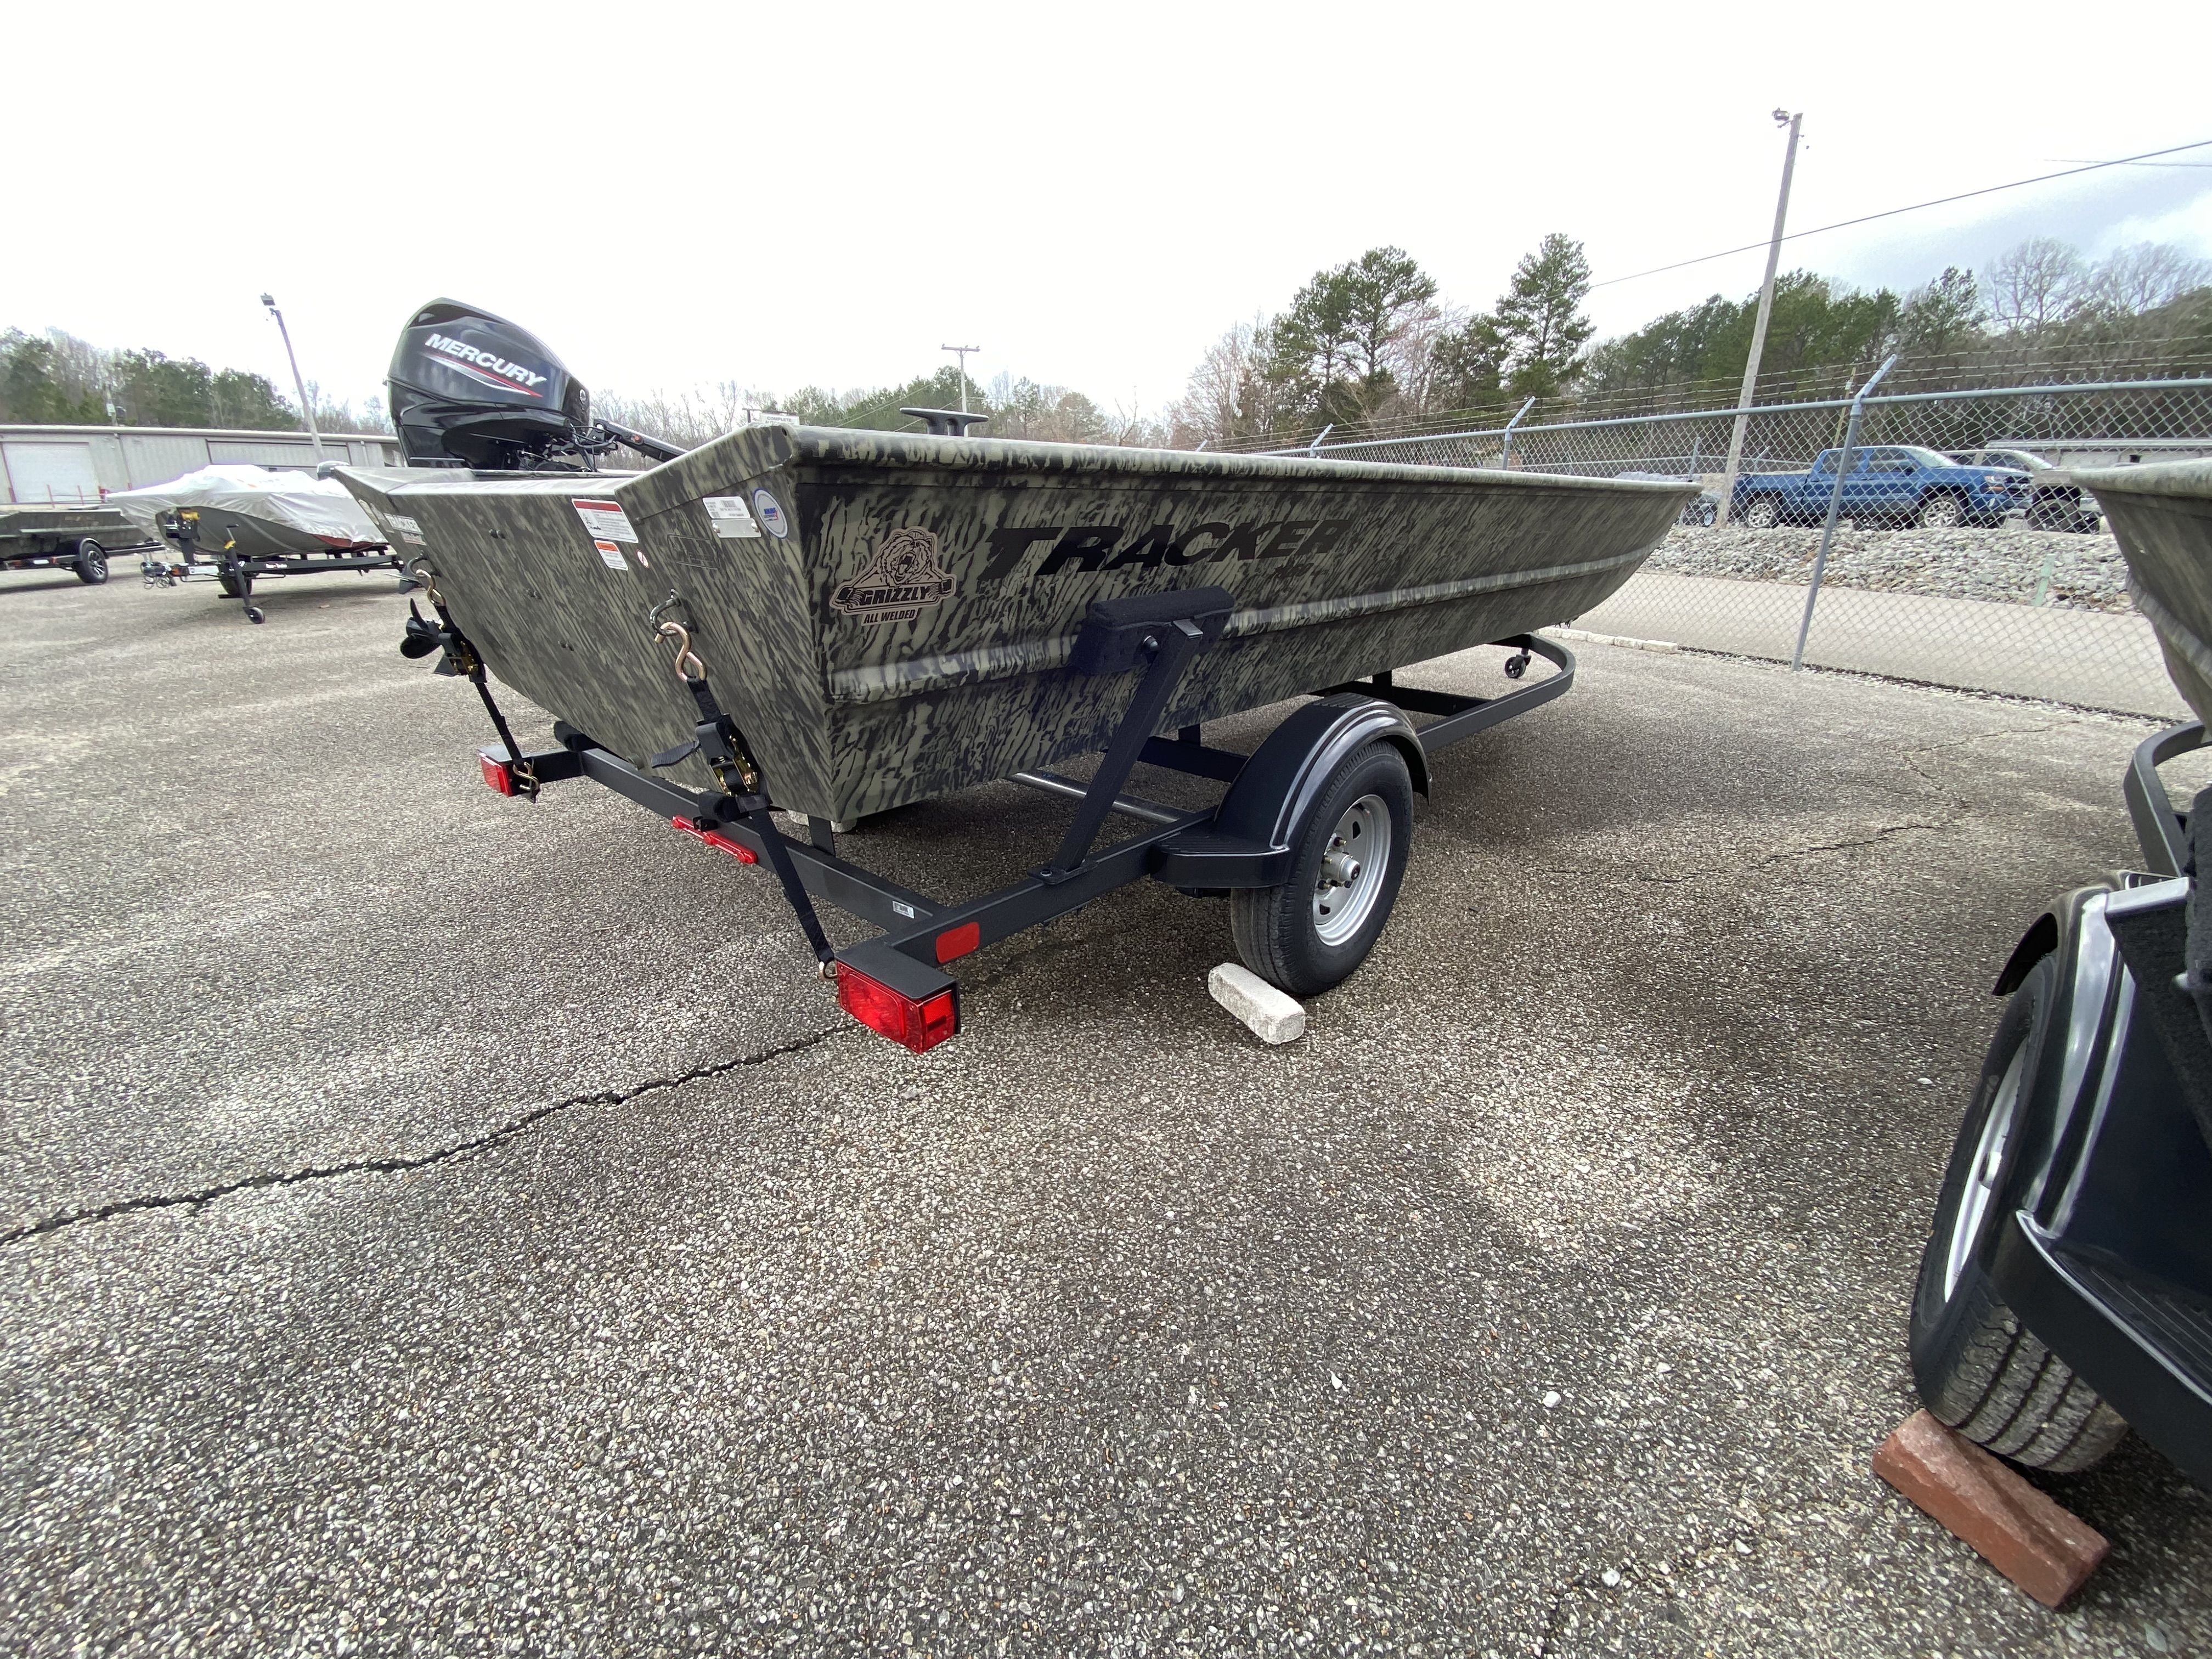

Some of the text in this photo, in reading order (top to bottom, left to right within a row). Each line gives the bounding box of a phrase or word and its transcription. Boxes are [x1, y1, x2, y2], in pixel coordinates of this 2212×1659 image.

[425, 333, 548, 386] MERCURY
[977, 519, 1353, 580] TRACKER
[860, 585, 931, 605] GRIZZLY
[864, 609, 916, 624] ALL WELDED
